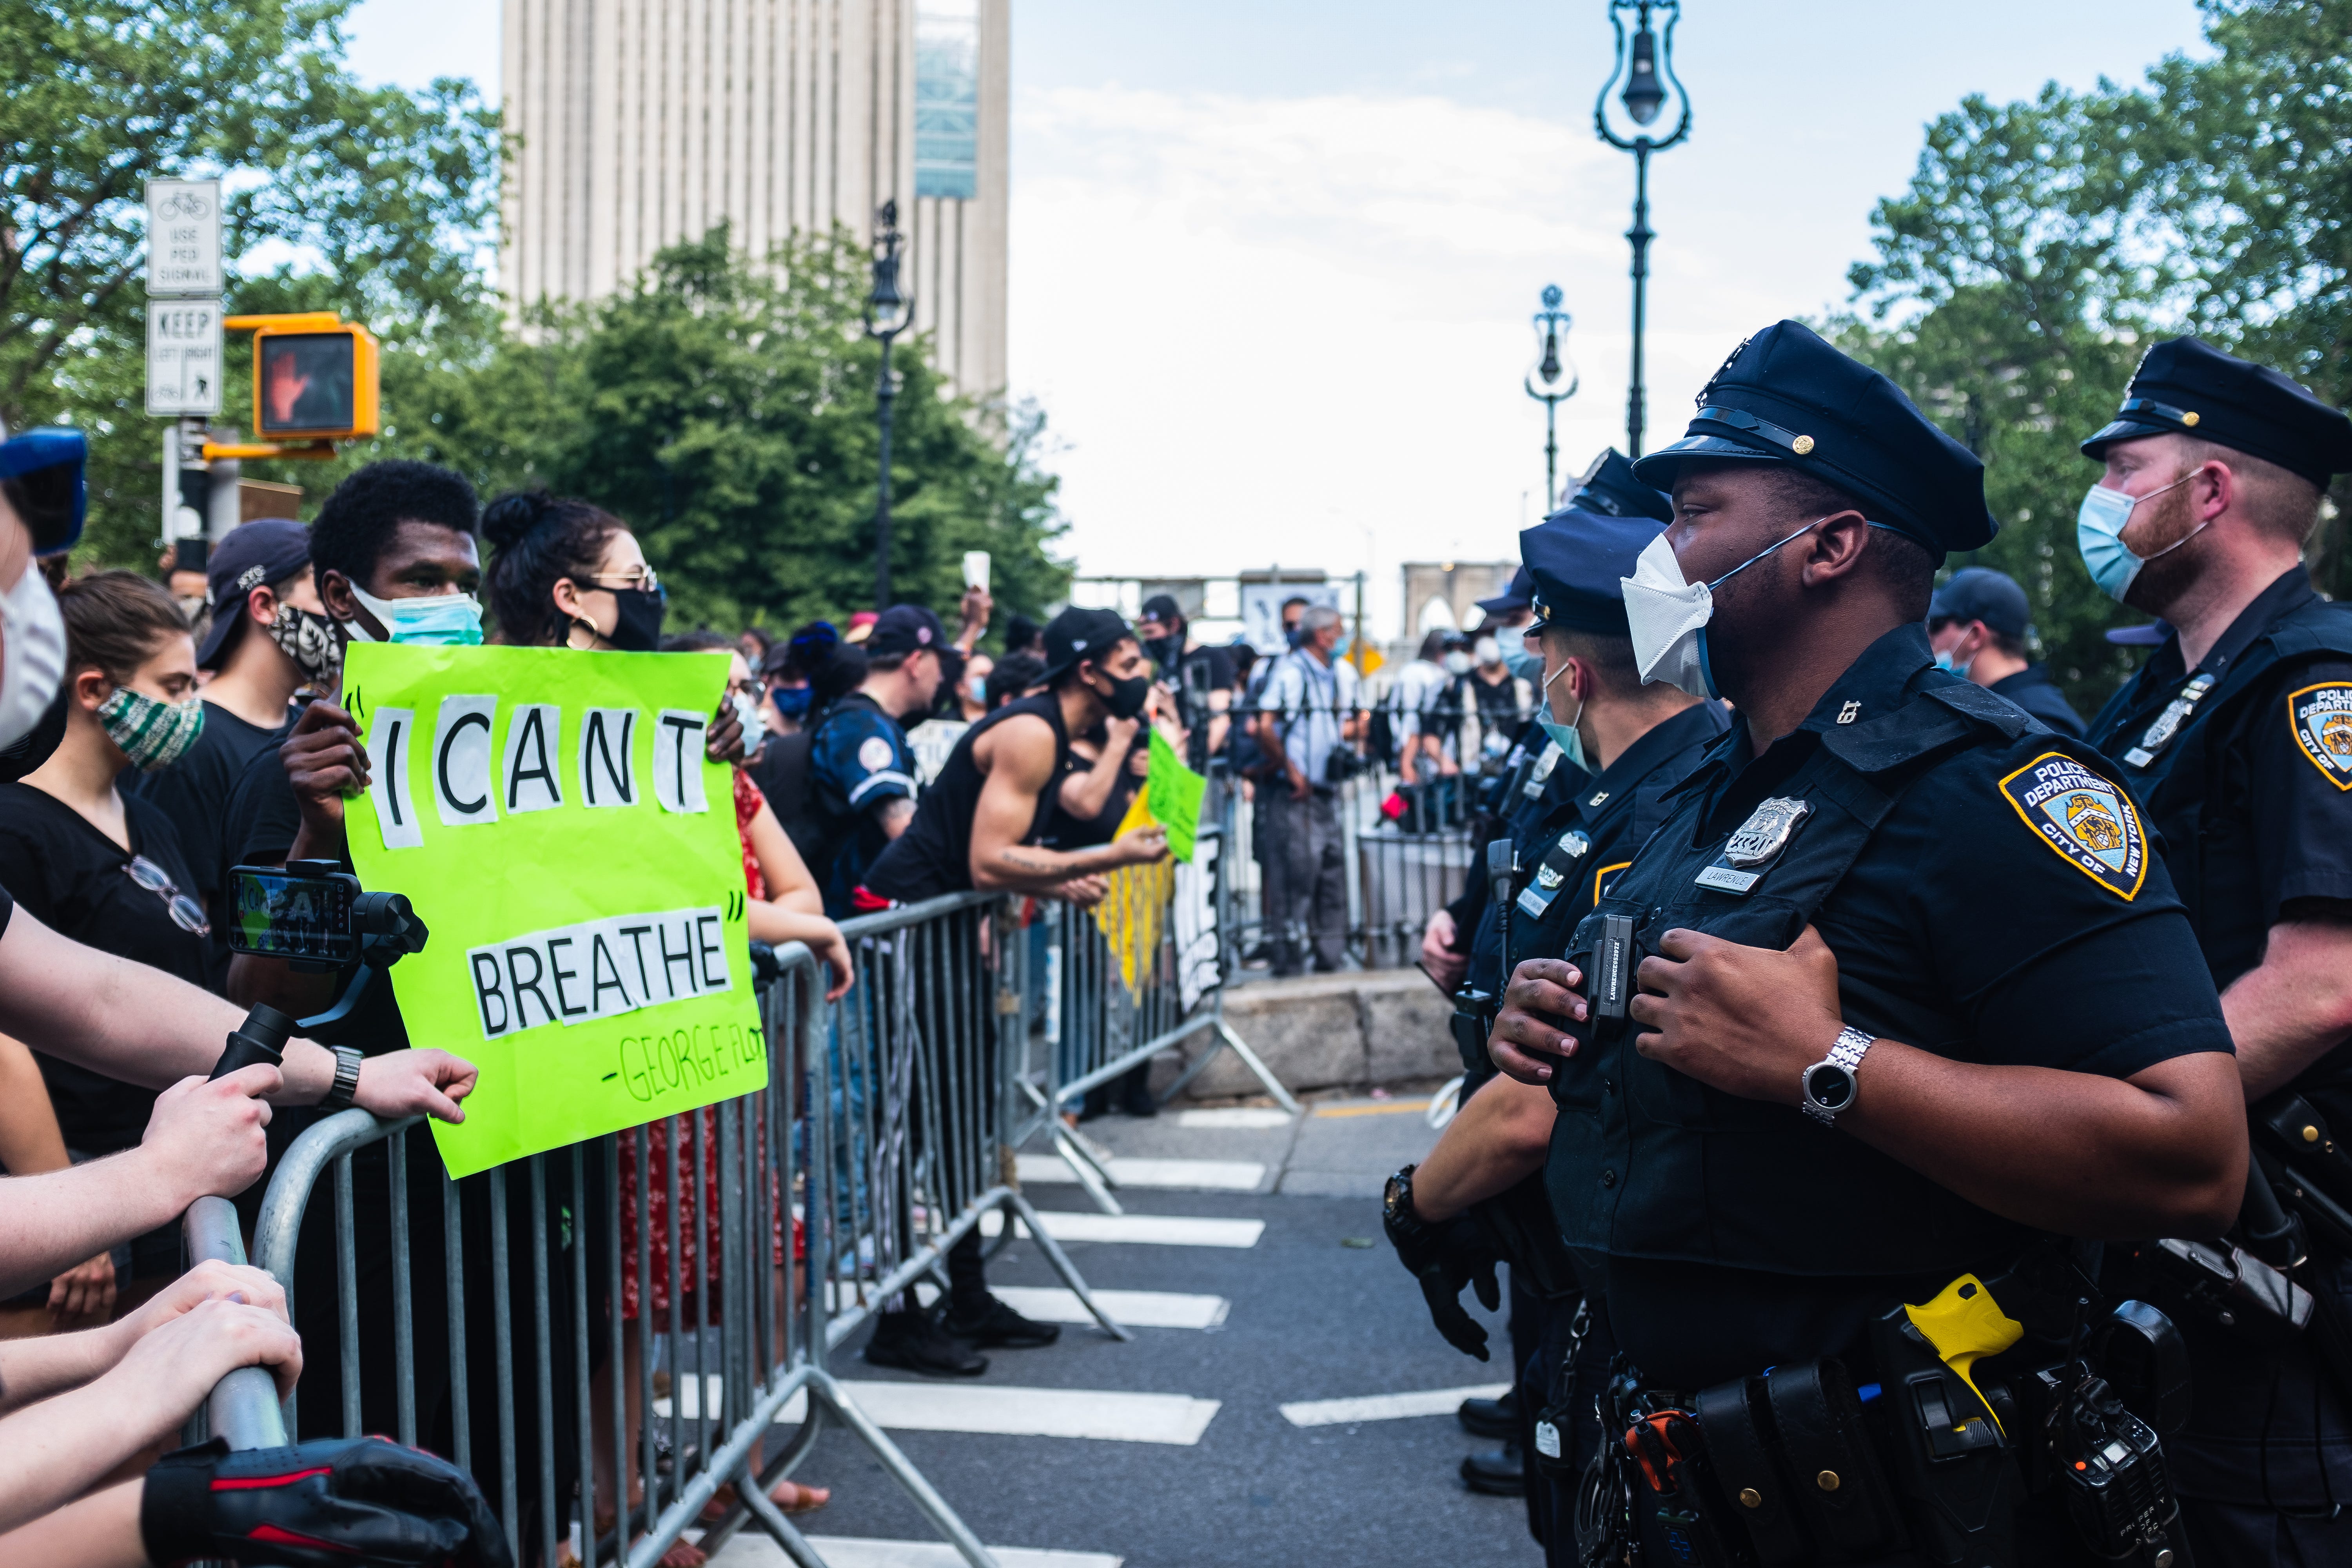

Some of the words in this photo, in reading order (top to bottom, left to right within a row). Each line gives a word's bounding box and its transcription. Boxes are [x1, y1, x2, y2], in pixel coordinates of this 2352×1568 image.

[169, 226, 198, 244] USE
[170, 246, 200, 263] PED
[158, 266, 210, 283] SIGNAL
[158, 310, 210, 339] KEEP
[438, 708, 703, 814] CANT
[2300, 729, 2321, 753] CITY
[2318, 753, 2334, 769] OF
[2034, 762, 2091, 782] POLICE
[2024, 775, 2116, 808] DEPARTMENT
[2121, 804, 2140, 844] YORK
[2042, 823, 2080, 855] CITY
[2081, 855, 2105, 874] OF
[2126, 847, 2140, 877] NEW
[1707, 871, 1749, 885] LAWRENCE
[2120, 1497, 2164, 1537] PRPERY
